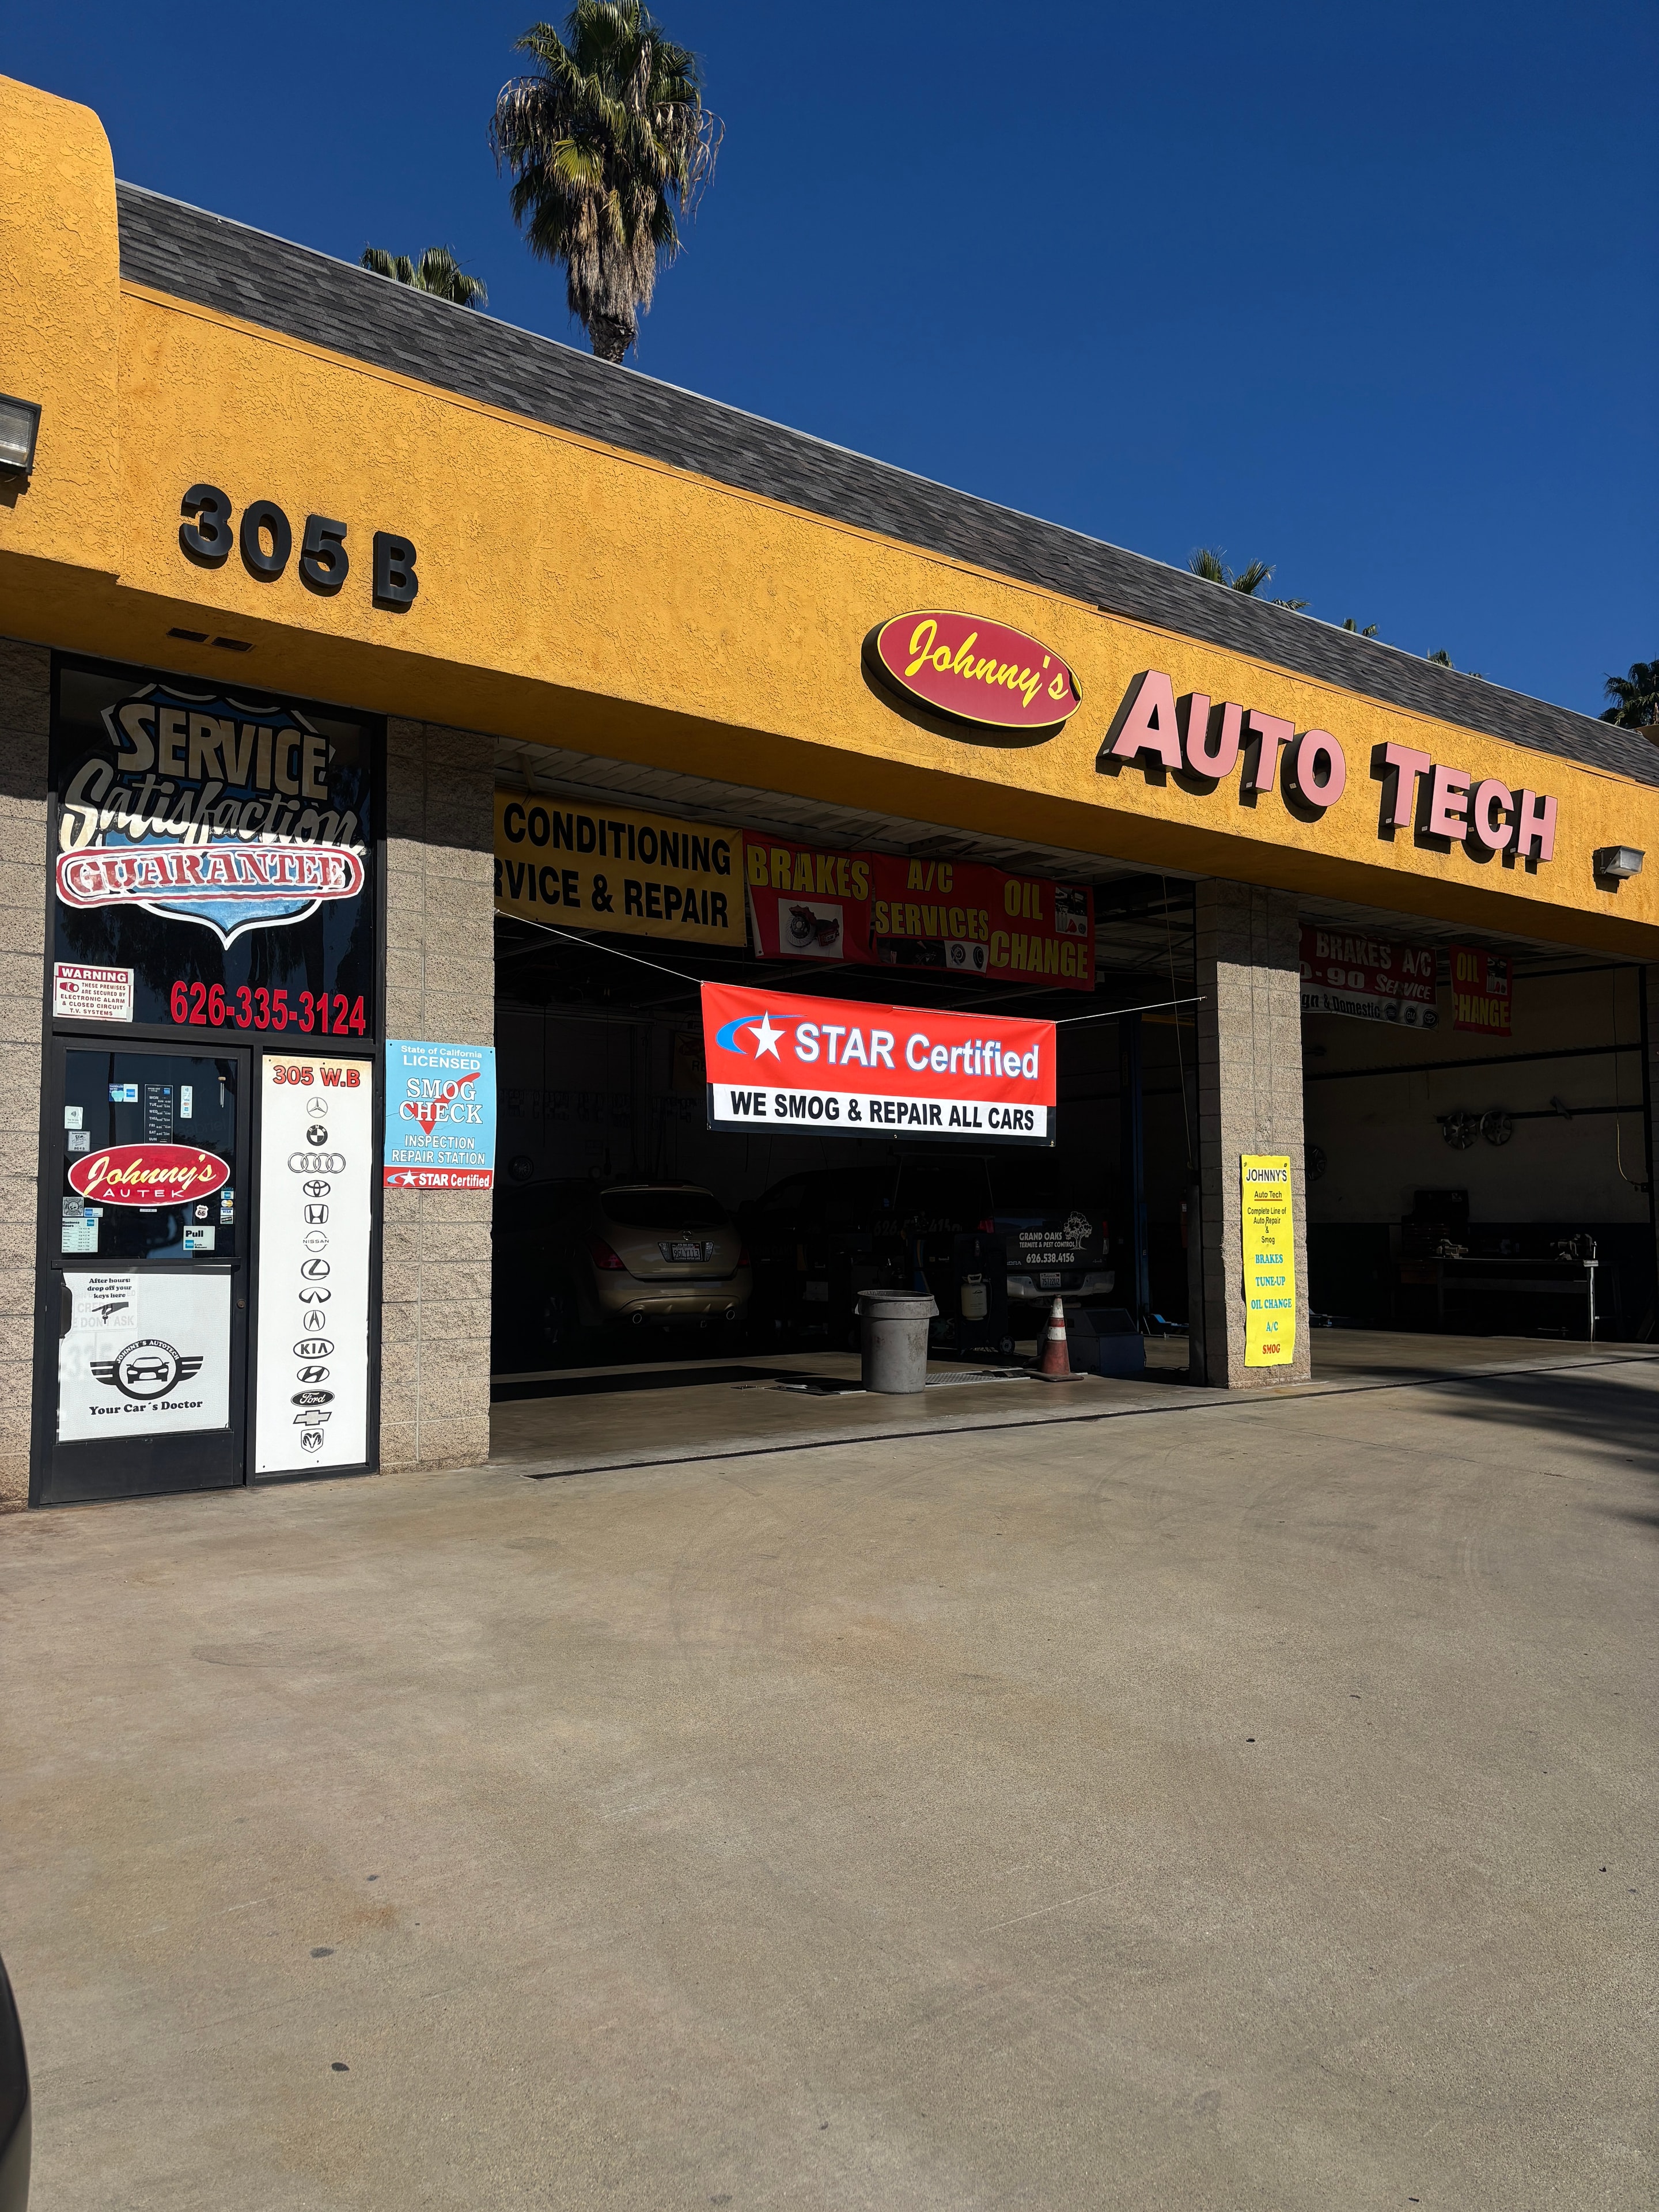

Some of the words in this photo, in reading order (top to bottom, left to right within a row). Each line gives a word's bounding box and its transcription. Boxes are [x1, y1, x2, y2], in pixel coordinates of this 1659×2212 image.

[180, 484, 349, 593] 305
[373, 531, 419, 613] B
[904, 619, 1069, 708] Johnny's
[118, 703, 329, 801] SERVICE
[1099, 669, 1346, 808] AUTO
[1374, 741, 1558, 862] TECH
[60, 758, 368, 855] Satisfaction
[503, 802, 732, 876] CONDITIONING
[70, 850, 347, 895] GUARANTEE
[747, 844, 870, 901] BRAKES
[907, 858, 953, 893] A/C
[591, 874, 615, 913] &
[624, 878, 729, 928] REPAIR
[1004, 879, 1044, 921] OIL
[875, 900, 990, 942] SERVICES
[989, 930, 1089, 979] CHANGE
[1316, 931, 1392, 970] BRAKES
[1402, 948, 1431, 977] A/C
[62, 968, 126, 982] WARNING
[1456, 952, 1480, 983] OIL
[60, 994, 101, 1002] ELECTRONIC
[1374, 973, 1432, 1000] SERVICE
[171, 980, 366, 1036] 626-335-3124
[1332, 995, 1381, 1018] Domestic
[401, 1046, 425, 1054] State
[440, 1048, 482, 1058] California
[403, 1055, 480, 1070] LICENSED
[794, 1022, 896, 1070] STAR
[906, 1033, 1039, 1080] Certified
[272, 1065, 315, 1086] 305
[320, 1067, 361, 1088] W.B
[406, 1077, 477, 1101] SMOG
[399, 1100, 483, 1124] CHECK
[730, 1091, 767, 1116] WE
[774, 1094, 840, 1121] SMOG
[848, 1099, 862, 1122] &
[870, 1100, 943, 1126] REPAIR
[949, 1105, 982, 1128] ALL
[988, 1108, 1035, 1131] CARS
[404, 1134, 475, 1150] INSPECTION
[392, 1149, 435, 1163] REPAIR
[437, 1152, 486, 1165] STATION
[84, 1154, 217, 1196] Johnny's
[419, 1173, 449, 1186] STAR
[450, 1174, 490, 1187] Certified
[1246, 1169, 1287, 1181] JOHNNY'S
[103, 1190, 184, 1198] AUTEK
[1247, 1207, 1270, 1216] Complete
[1266, 1217, 1281, 1225] Repair
[1018, 1232, 1043, 1241] GRAND
[1044, 1232, 1062, 1240] OAKS
[1261, 1236, 1275, 1244] Smog
[1026, 1253, 1075, 1264] 626.538.4156
[1255, 1254, 1283, 1264] BRAKES
[1255, 1277, 1286, 1286] TUNE-UP
[1251, 1300, 1262, 1309] OIL
[1264, 1298, 1292, 1309] CHANGE
[1266, 1321, 1278, 1332] A/C
[149, 1340, 180, 1361] AUTOTECH
[301, 1343, 328, 1354] KIA
[1262, 1344, 1281, 1354] SMOG
[89, 1406, 121, 1415] Your
[161, 1401, 203, 1410] Doctor
[300, 1393, 325, 1404] Ford
